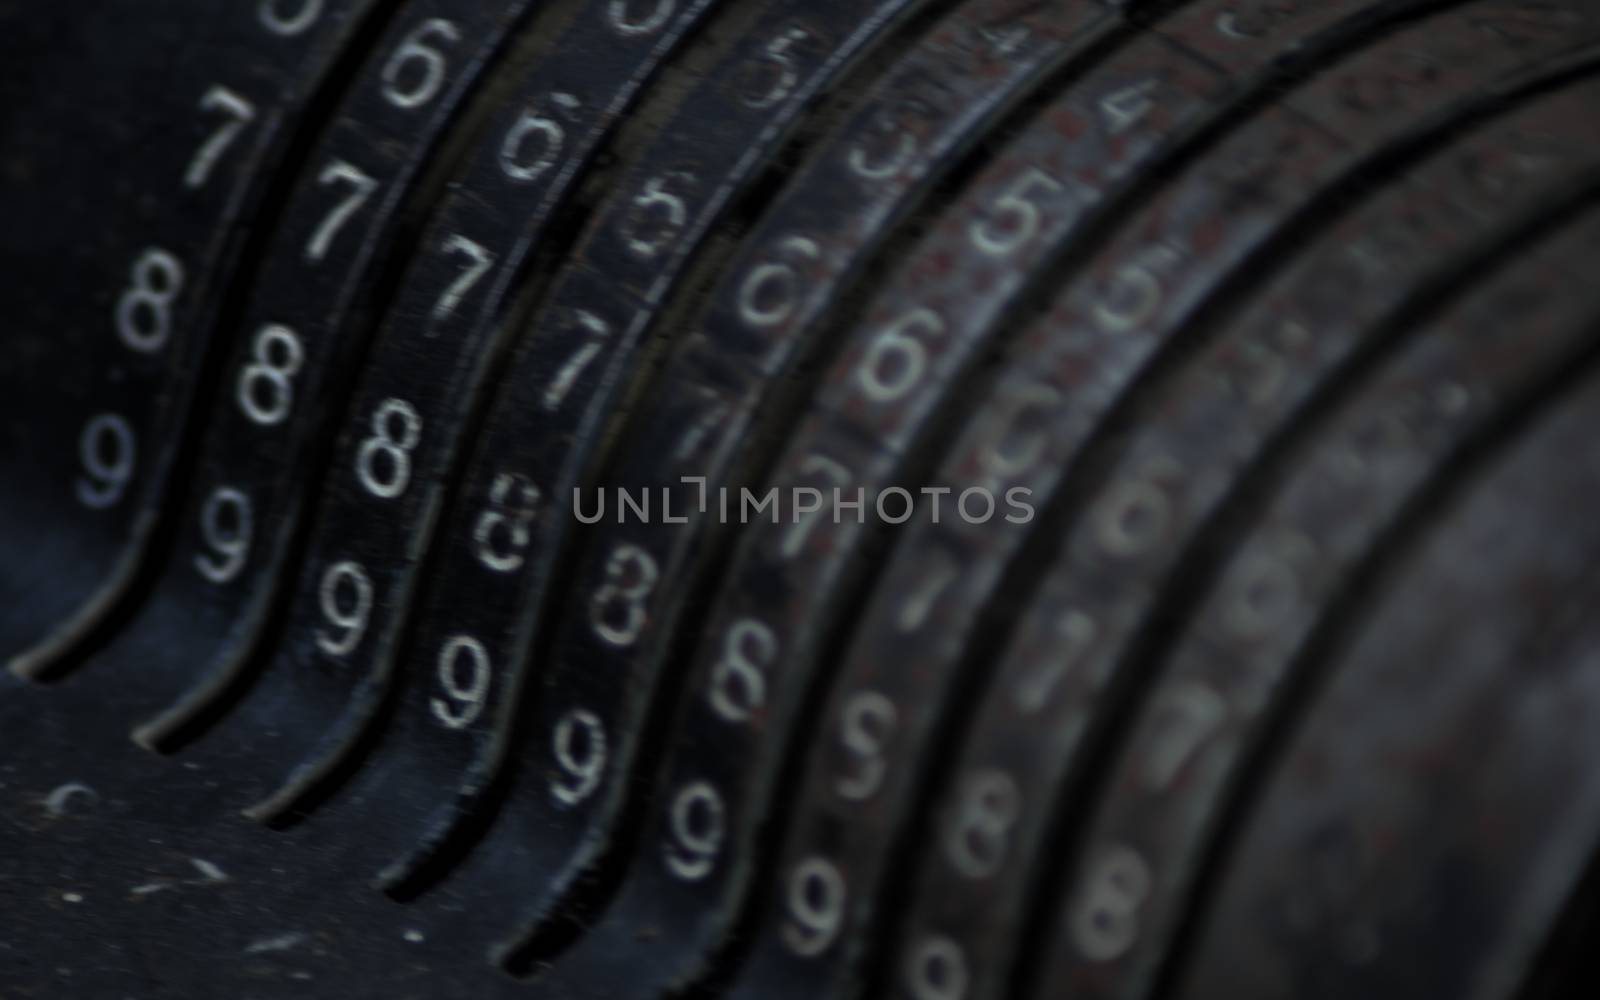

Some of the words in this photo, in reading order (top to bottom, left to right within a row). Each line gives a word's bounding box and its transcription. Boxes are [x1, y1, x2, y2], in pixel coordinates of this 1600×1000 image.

[381, 17, 463, 109] 6
[183, 84, 257, 191] 7
[500, 91, 581, 181] 6
[305, 158, 381, 262] 7
[967, 165, 1063, 256] 5
[114, 246, 185, 354] 8
[431, 233, 497, 334] 7
[235, 323, 305, 427] 8
[542, 308, 609, 413] 7
[855, 308, 945, 401] 6
[76, 413, 137, 509] 9
[355, 398, 423, 500] 8
[193, 486, 254, 584] 9
[473, 473, 543, 573] 8
[313, 561, 374, 656] 9
[591, 543, 660, 647] 8
[430, 634, 492, 730] 9
[706, 616, 777, 723] 8
[549, 707, 607, 809] 9
[663, 778, 726, 881] 9
[941, 765, 1022, 879] 8
[778, 854, 848, 958] 9
[1067, 842, 1152, 962] 8
